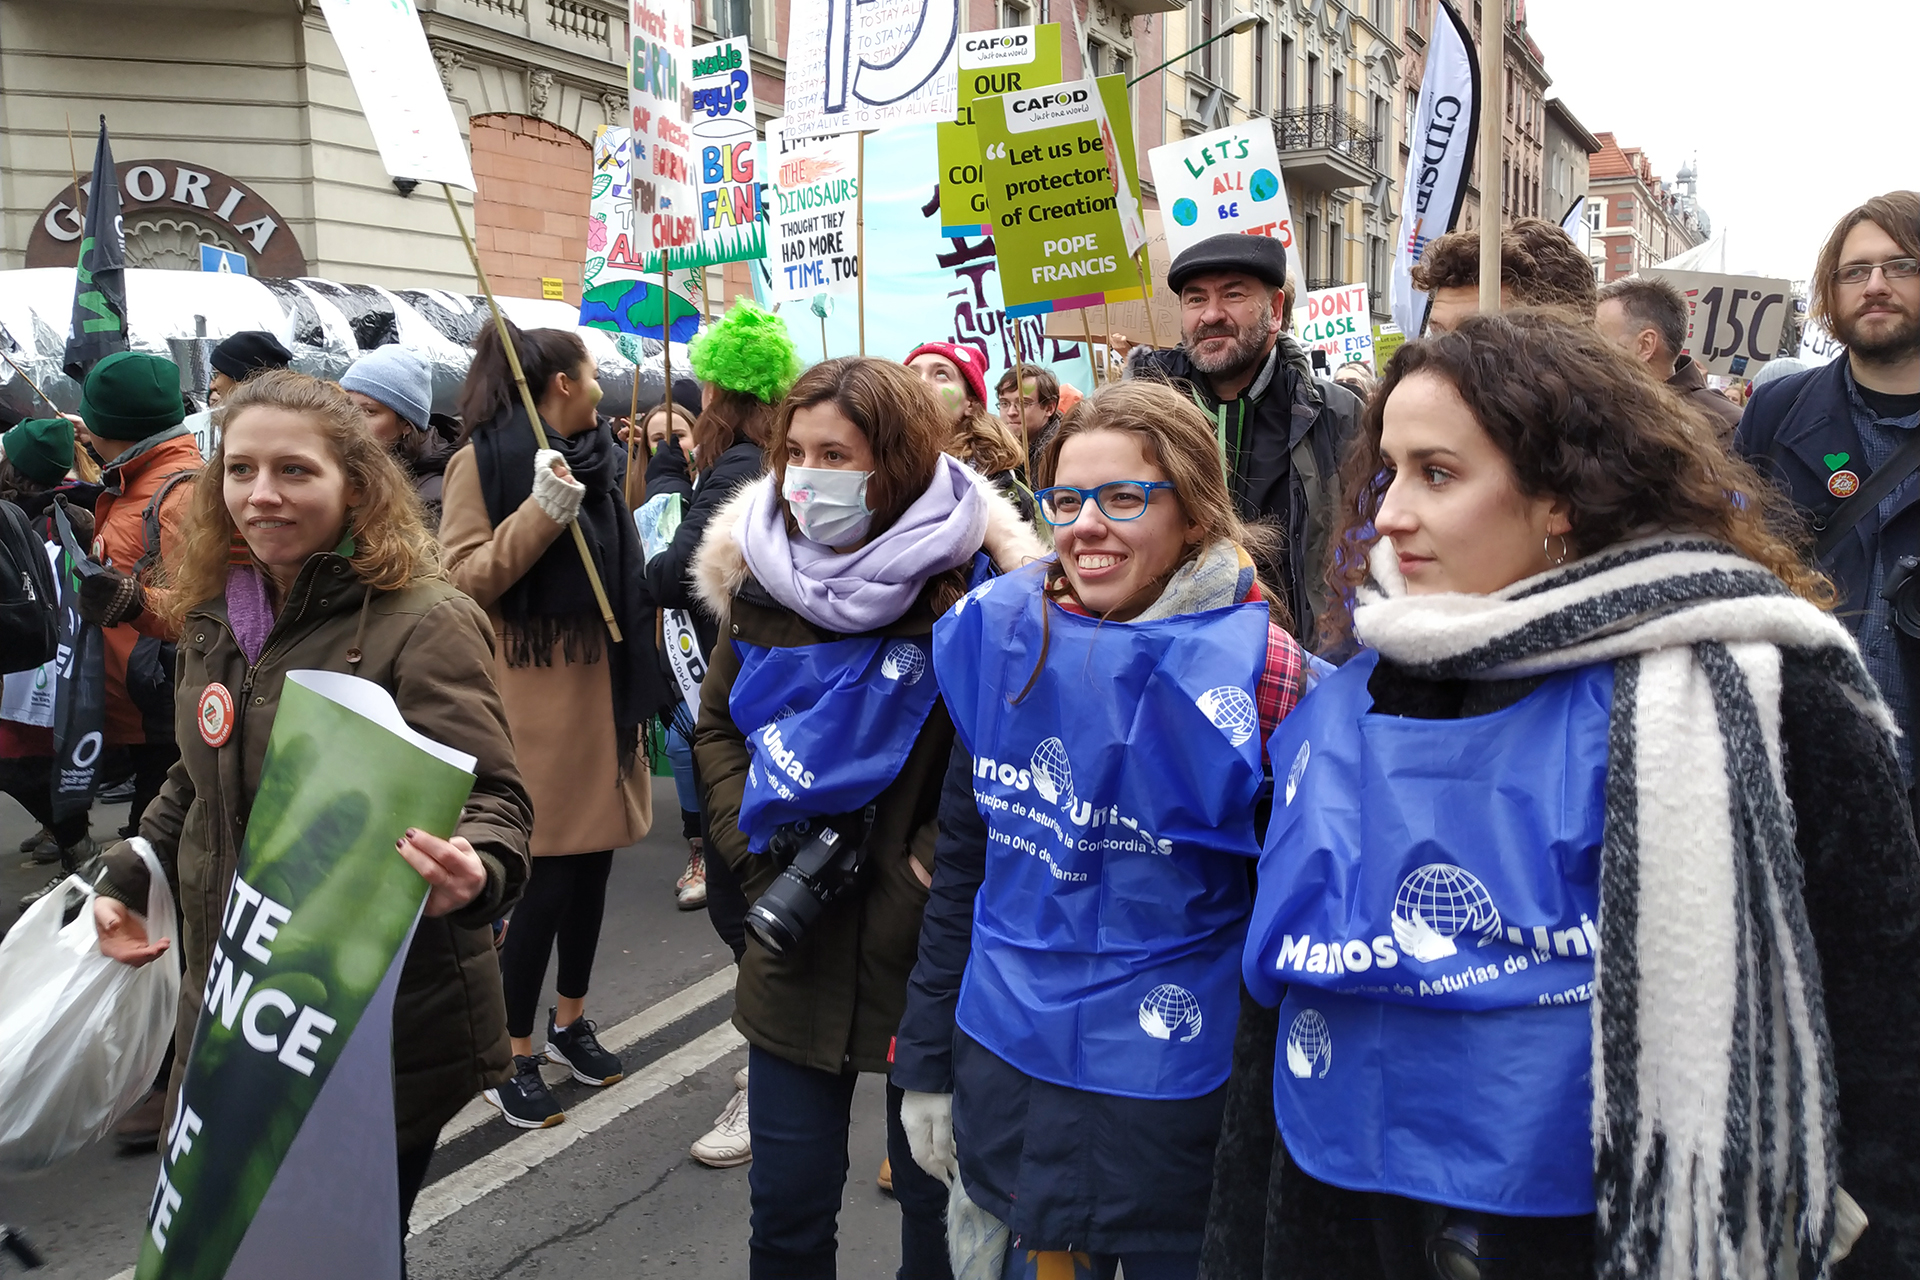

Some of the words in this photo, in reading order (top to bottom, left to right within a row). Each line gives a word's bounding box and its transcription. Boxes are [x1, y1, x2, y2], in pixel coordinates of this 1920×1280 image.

[966, 35, 1028, 52] CAFOD
[633, 35, 678, 103] EARTH
[974, 72, 1022, 95] OUR
[797, 92, 819, 109] STAY
[874, 104, 902, 120] STAY
[1012, 89, 1088, 114] CAFOD
[1048, 142, 1073, 158] us
[1077, 136, 1104, 154] be
[1184, 135, 1250, 180] LET'S
[702, 141, 754, 184] BIG
[781, 159, 806, 184] THE
[772, 178, 858, 216] DINOSAURS
[1212, 171, 1244, 196] ALL
[44, 165, 279, 255] GORIA
[701, 182, 762, 231] FAN!
[1001, 206, 1023, 228] of
[1028, 195, 1117, 223] Creation
[1218, 202, 1240, 220] BE
[781, 216, 819, 238] THOUGHT
[821, 211, 846, 230] THEY
[782, 239, 805, 264] HAD
[808, 230, 844, 257] MORE
[1043, 233, 1099, 258] POPE
[784, 259, 830, 291] TIME,
[1031, 255, 1118, 285] FRANCIS
[1308, 287, 1365, 321] DON'T
[1303, 316, 1356, 343] CLOSE
[1345, 335, 1372, 352] EYES
[1344, 352, 1362, 363] TO
[1012, 802, 1027, 817] de
[1064, 833, 1074, 850] la
[1077, 838, 1147, 854] Concordia
[988, 826, 1011, 845] Una
[1012, 836, 1036, 857] ONG
[1039, 848, 1051, 864] de
[1276, 933, 1398, 975] Manos
[1419, 963, 1500, 998] Asturias
[1503, 954, 1529, 975] de
